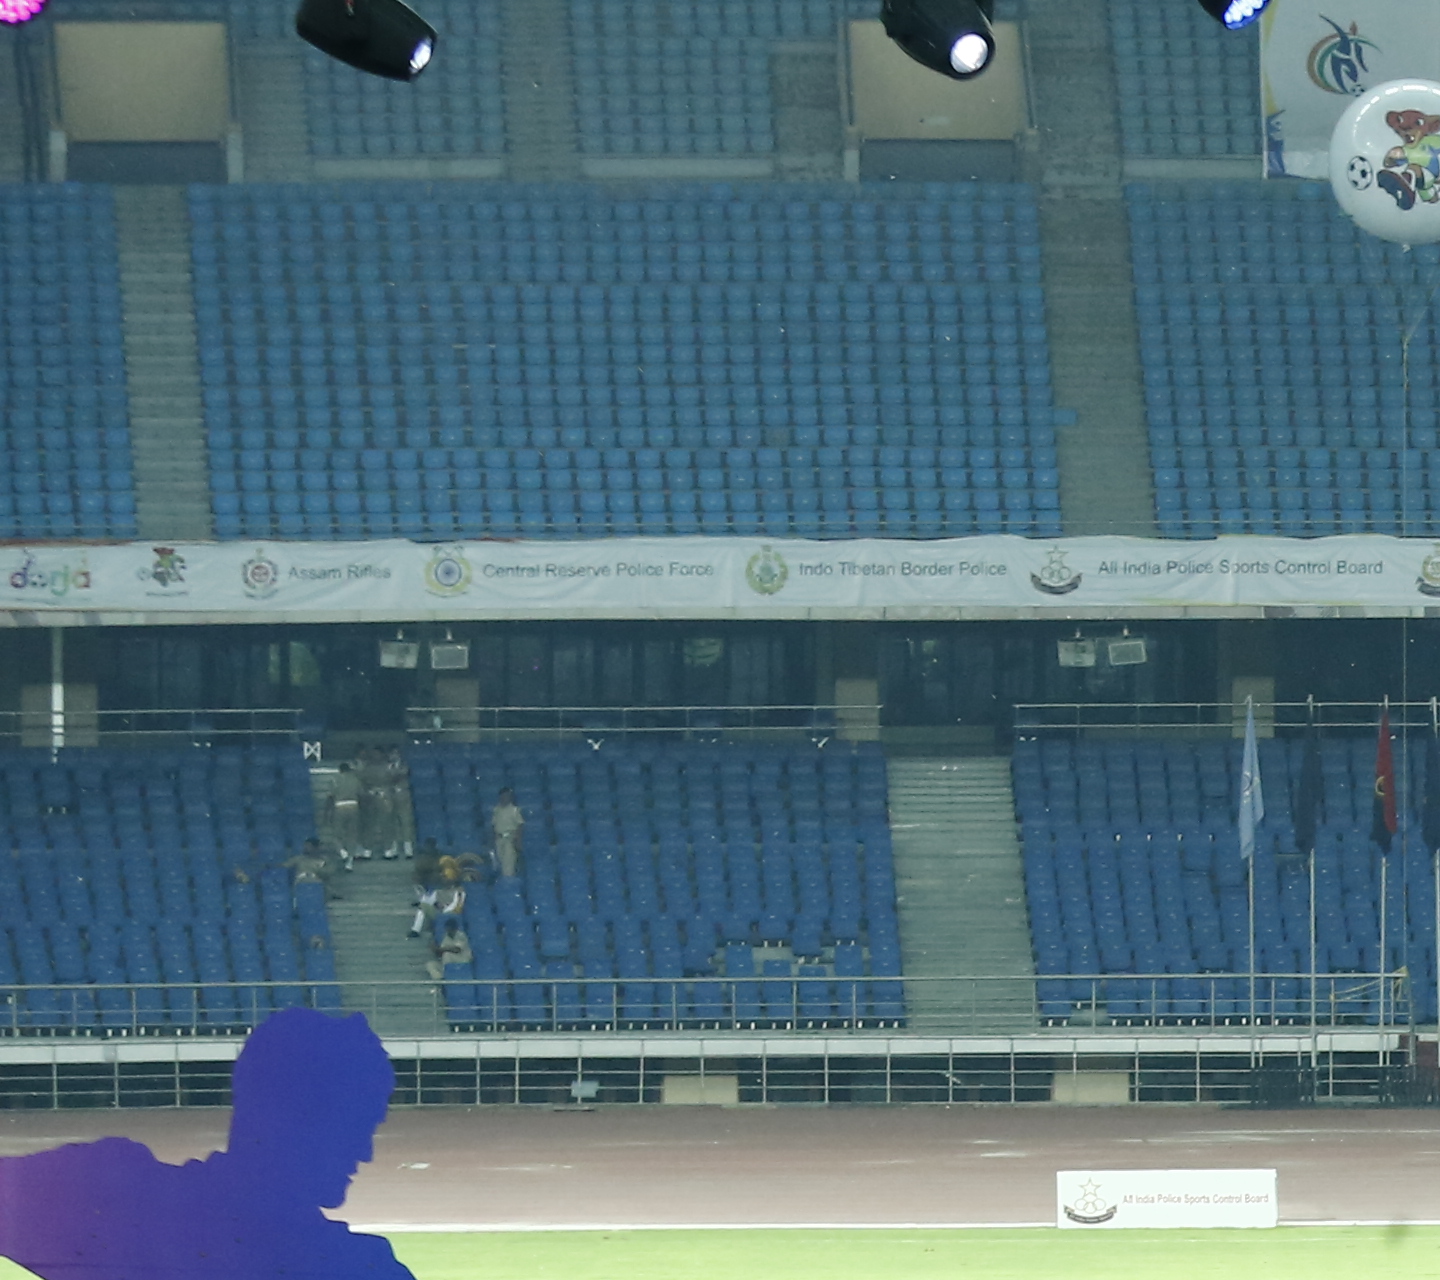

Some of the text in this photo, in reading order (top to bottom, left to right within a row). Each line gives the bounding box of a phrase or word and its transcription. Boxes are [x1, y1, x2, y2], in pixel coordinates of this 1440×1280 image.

[288, 565, 393, 581] Assam Rifles
[483, 562, 714, 577] Central Reserve Police Force
[799, 562, 1007, 576] Indo Tibetan Border Police
[1098, 560, 1383, 577] All India Police Sports Control Board
[1122, 1193, 1269, 1206] All India Police Sports Control Board
